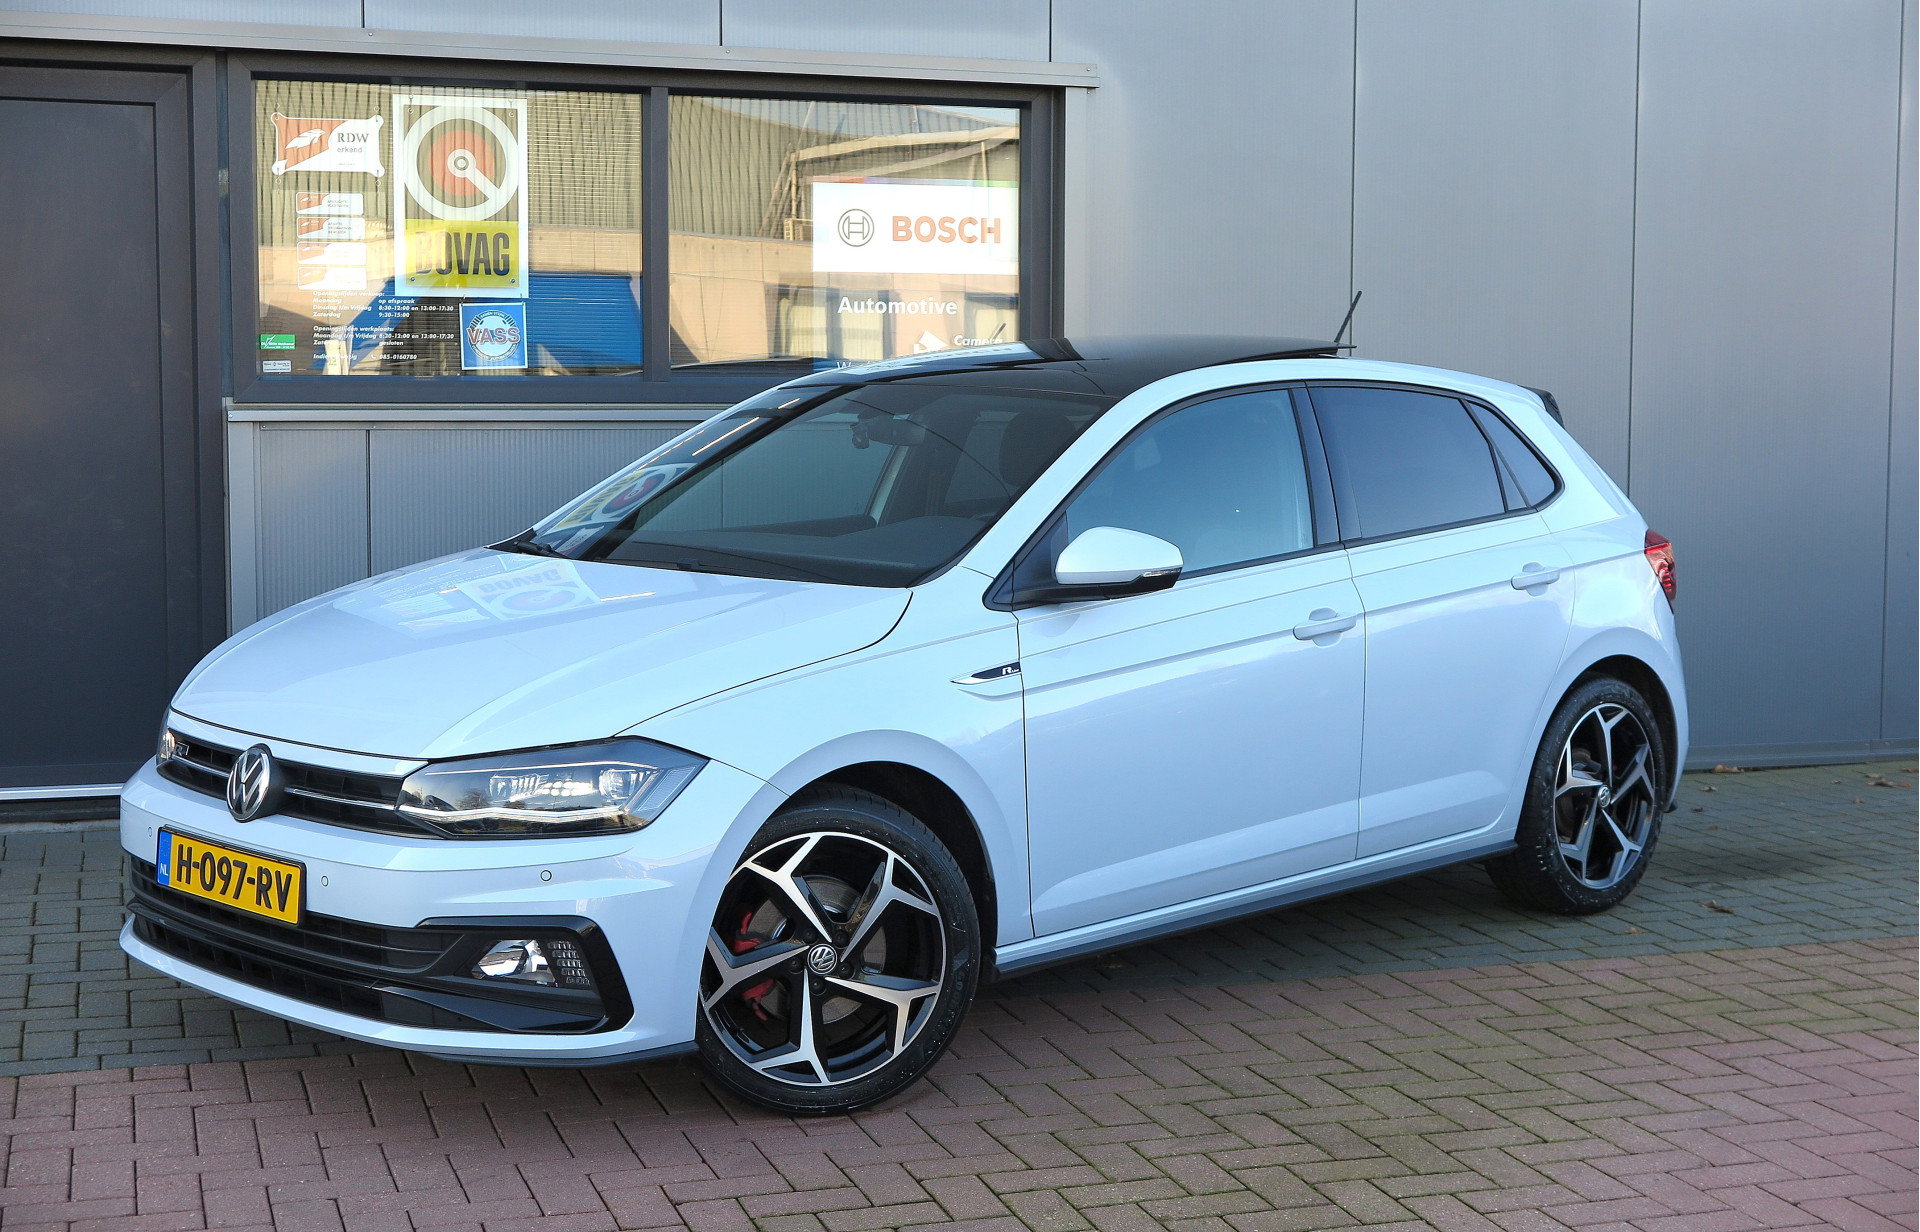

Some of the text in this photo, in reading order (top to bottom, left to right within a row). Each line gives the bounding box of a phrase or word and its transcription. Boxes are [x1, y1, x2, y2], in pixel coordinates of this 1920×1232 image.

[337, 132, 369, 143] RDW
[892, 216, 1001, 243] BOSCH
[415, 231, 510, 276] BOVAG
[837, 296, 958, 315] Automotive
[466, 327, 521, 344] VASS
[160, 863, 169, 877] NL
[176, 843, 293, 912] H-097-RV
